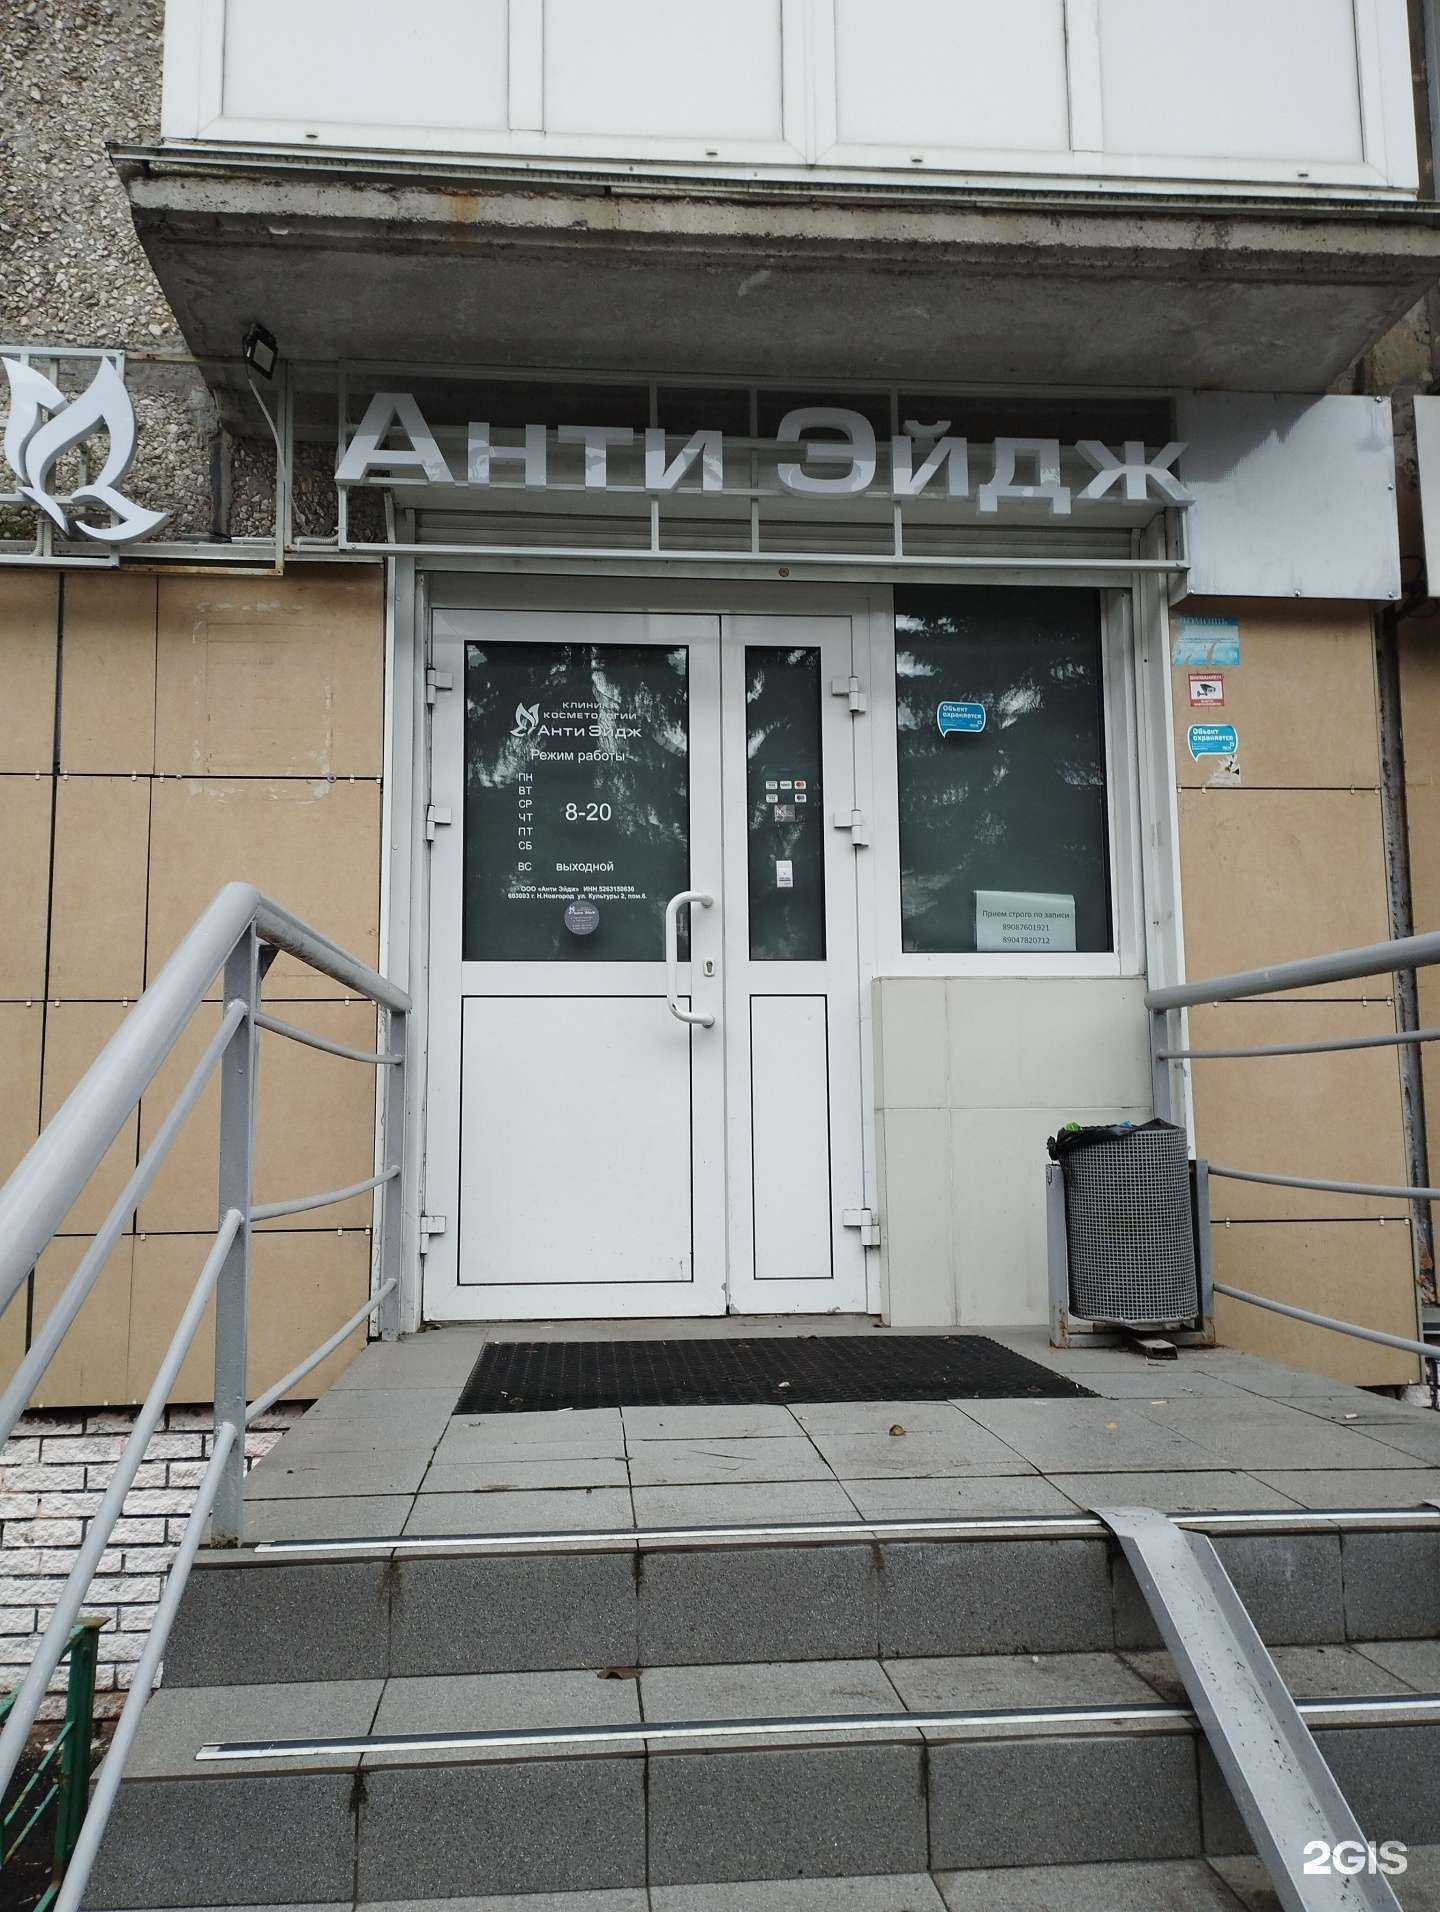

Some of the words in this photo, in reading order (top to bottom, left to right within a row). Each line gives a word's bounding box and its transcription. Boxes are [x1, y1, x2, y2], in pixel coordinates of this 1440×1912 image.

[334, 392, 723, 495] Анти
[776, 406, 1198, 515] Эйдж
[538, 724, 585, 737] Анти
[531, 749, 574, 761] Режим
[578, 749, 625, 763] работы
[518, 772, 533, 782] ПН
[518, 786, 533, 795] ВТ
[518, 799, 533, 809] СР
[565, 802, 612, 821] 8-20
[518, 813, 533, 822] ЧТ
[518, 827, 533, 836] ПТ
[518, 841, 533, 850] СБ
[518, 862, 532, 871] ВС
[536, 892, 575, 900] Н.Новгород
[588, 892, 619, 900] Культуры
[982, 910, 1007, 918] Прием
